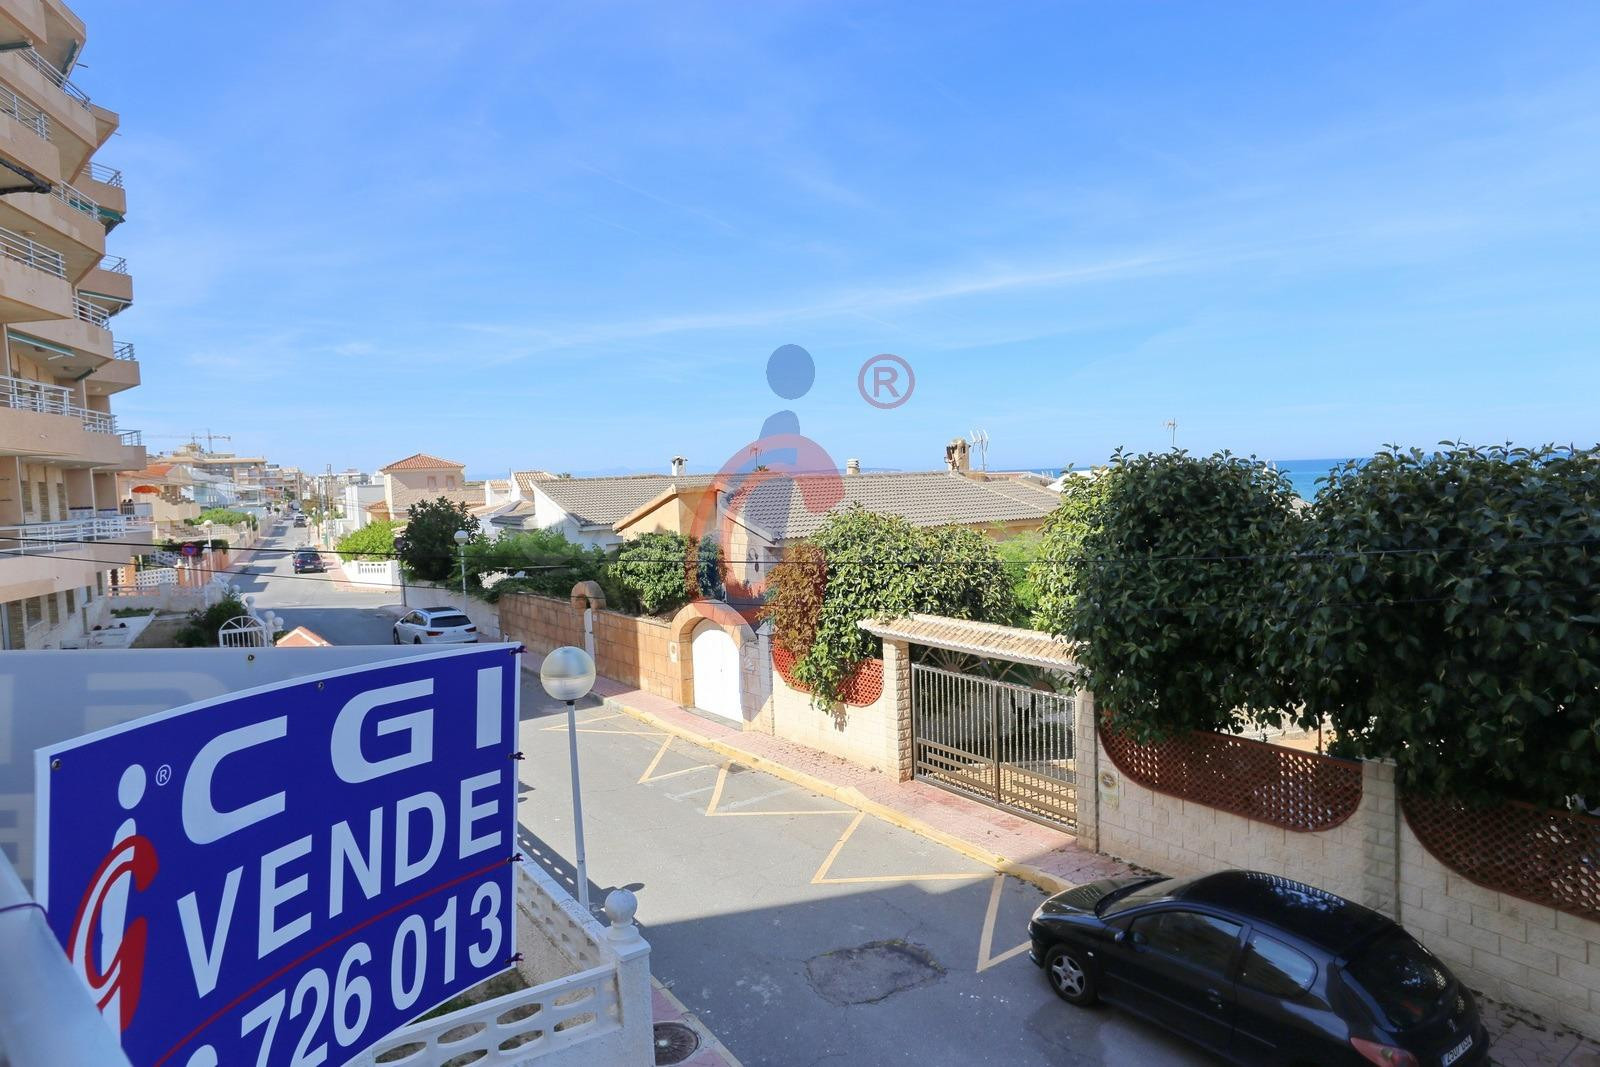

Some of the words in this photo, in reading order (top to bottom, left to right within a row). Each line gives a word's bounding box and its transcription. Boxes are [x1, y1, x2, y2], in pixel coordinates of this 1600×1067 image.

[181, 665, 502, 845] CGI
[176, 769, 502, 999] VENDE
[240, 941, 372, 1067] 726
[390, 880, 503, 1011] 013
